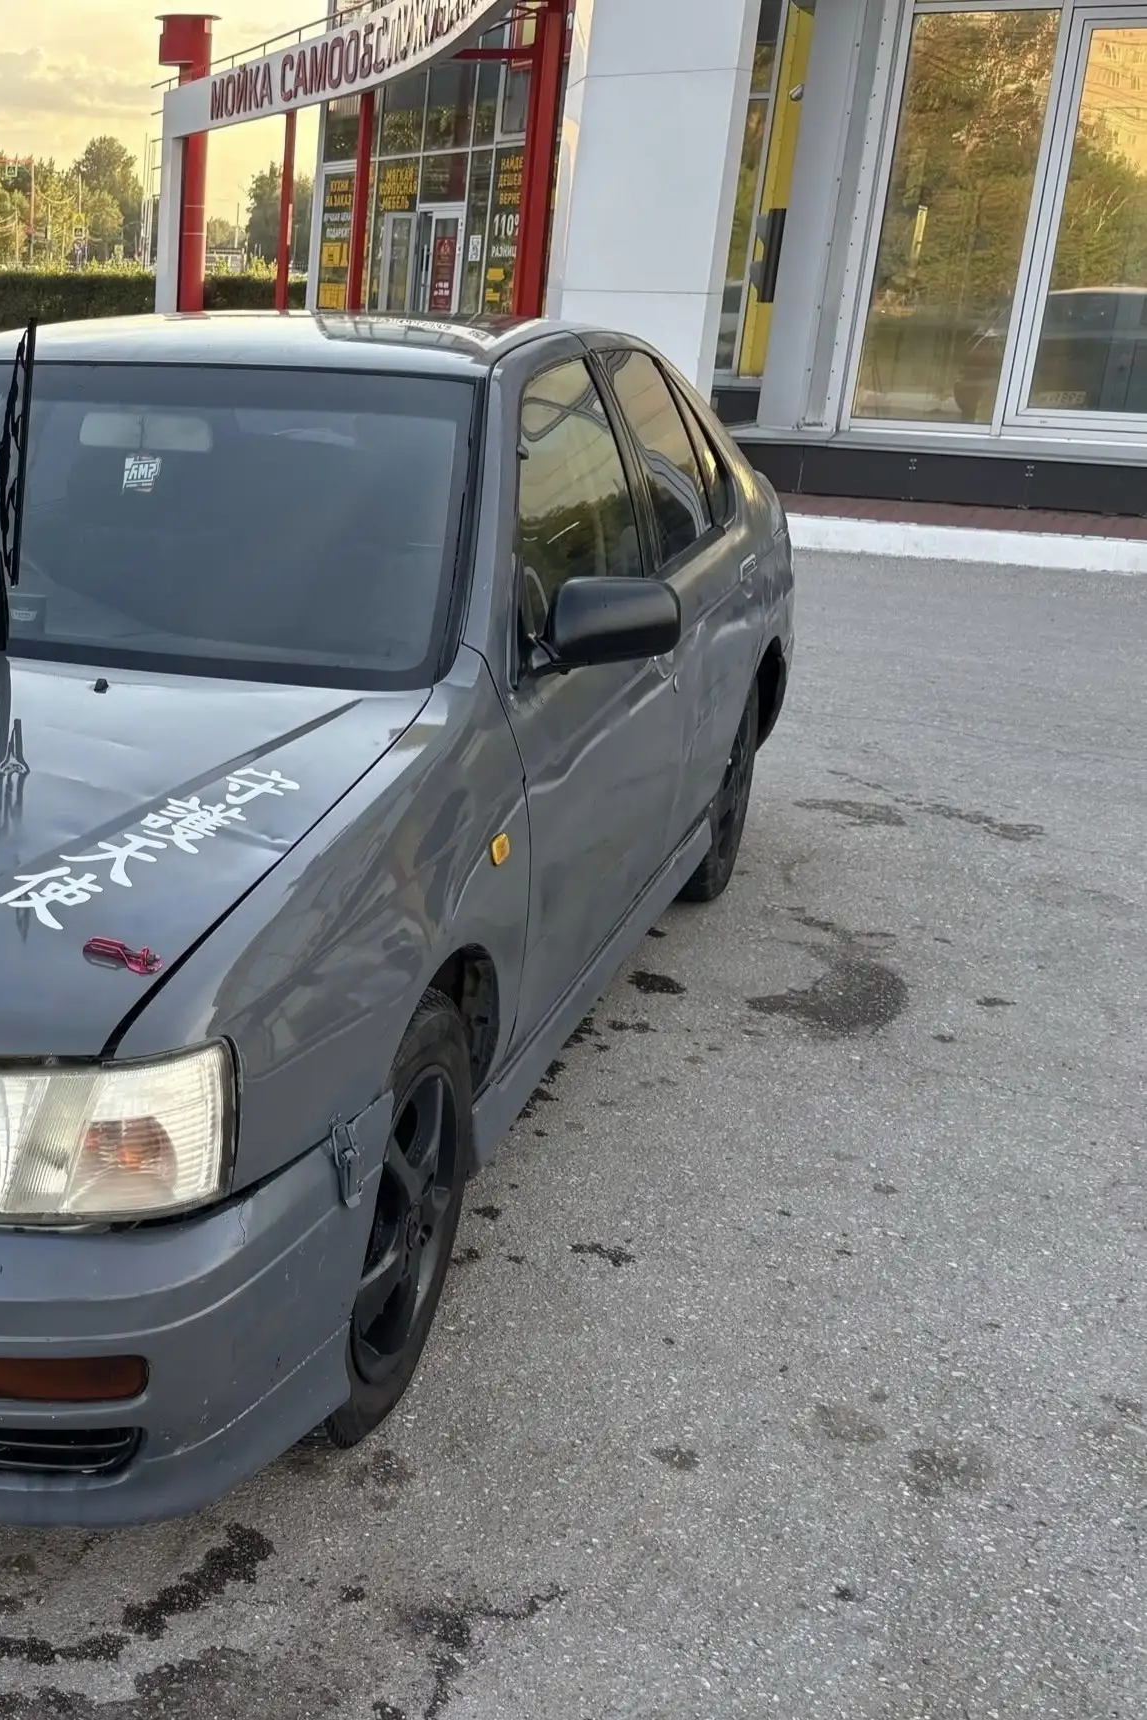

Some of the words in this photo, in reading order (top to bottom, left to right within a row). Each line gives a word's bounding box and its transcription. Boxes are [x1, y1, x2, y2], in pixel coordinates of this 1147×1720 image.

[210, 63, 273, 120] МОЙКА
[501, 155, 524, 170] НАЙДЕ
[386, 167, 414, 182] МЯГКАЯ
[498, 173, 522, 188] ДЕШЕВ
[382, 195, 409, 210] МЕБЕЛЬ
[500, 192, 521, 204] ВЕРНЕ
[491, 245, 517, 259] РАЗНИЦ
